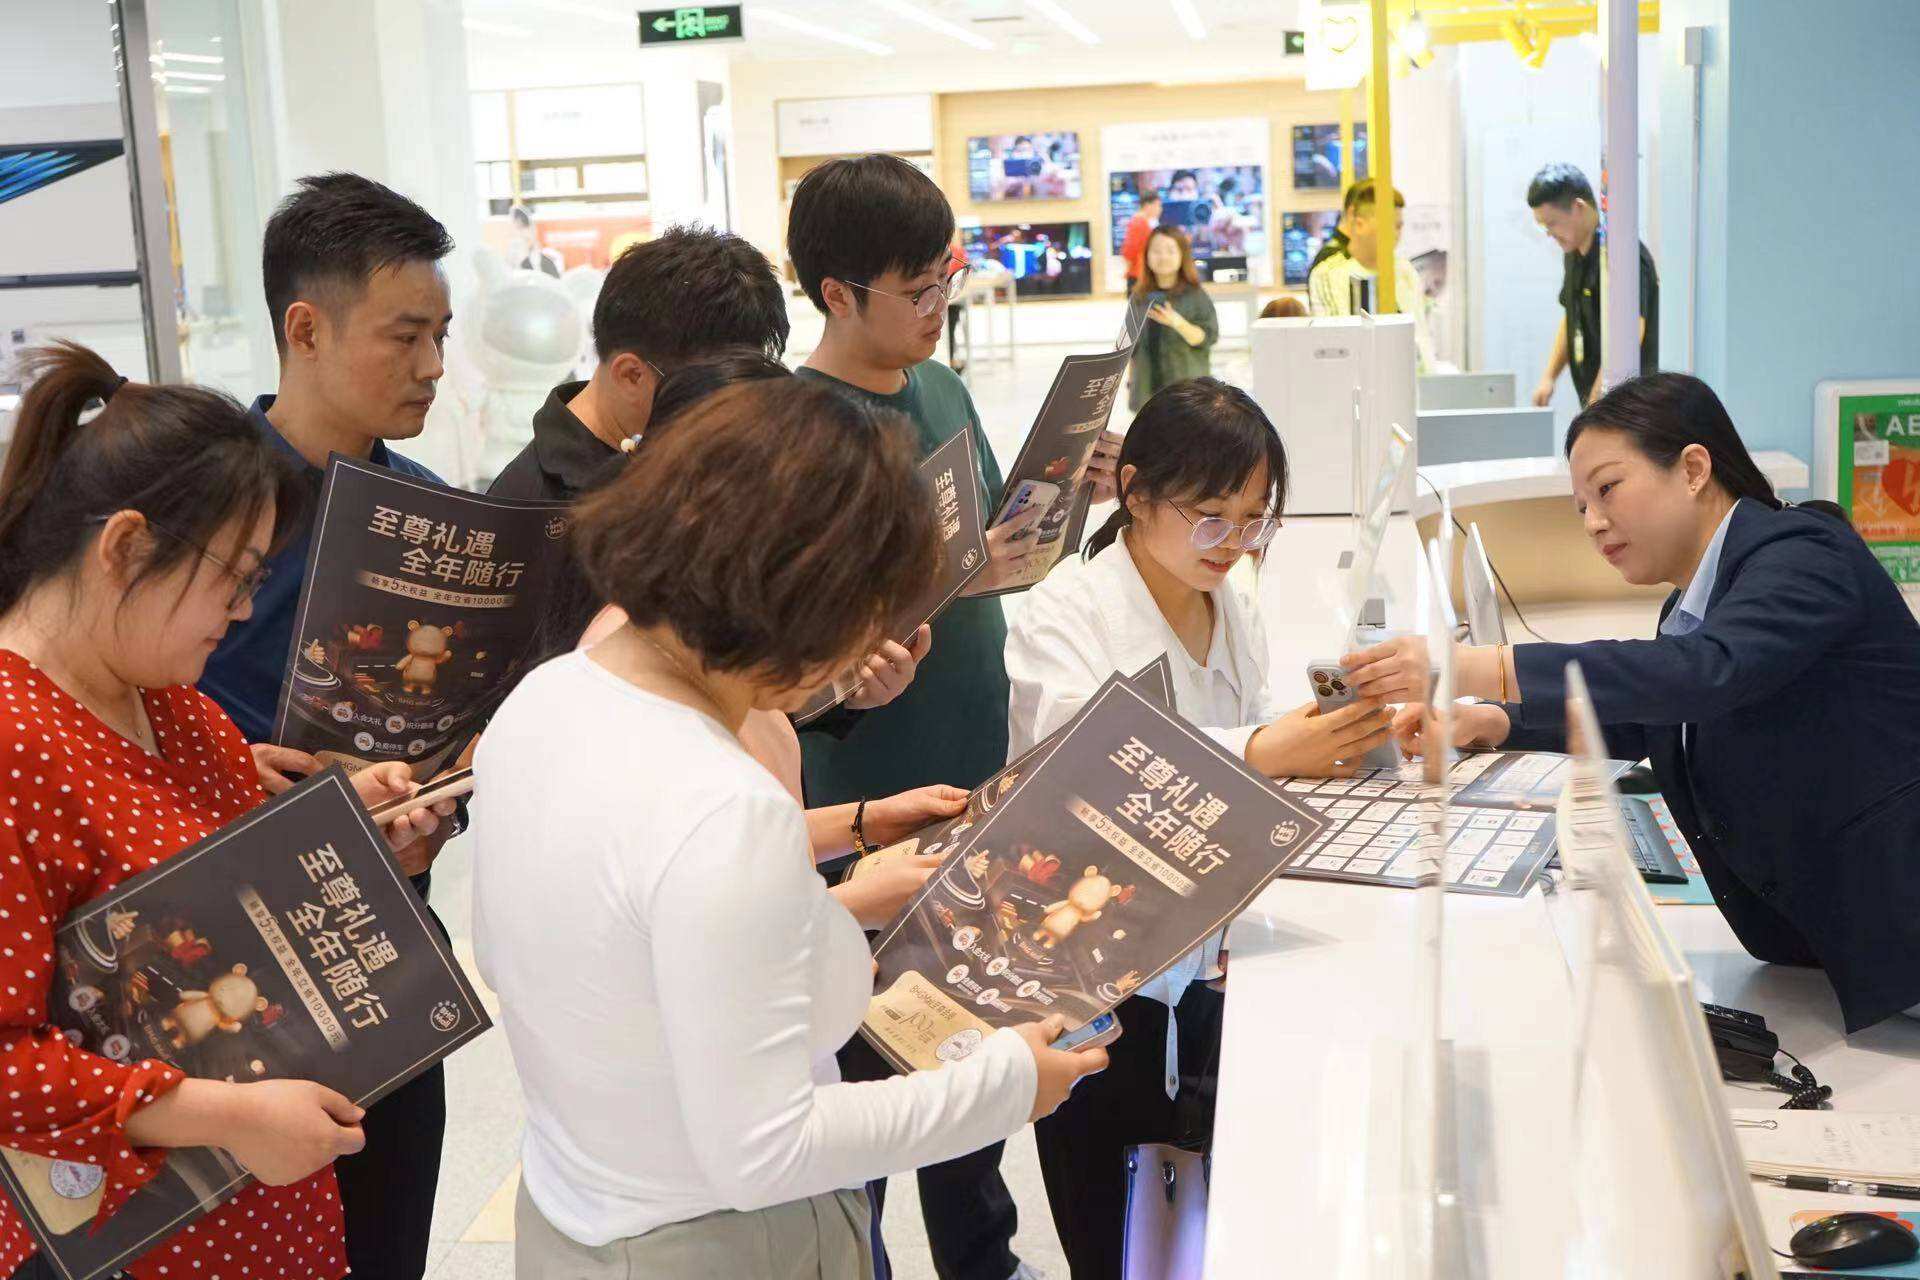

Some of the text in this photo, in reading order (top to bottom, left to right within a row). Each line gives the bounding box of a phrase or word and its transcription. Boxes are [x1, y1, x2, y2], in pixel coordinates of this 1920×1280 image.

[367, 505, 496, 559] 至尊礼遇
[399, 548, 524, 588] 全年随行
[1108, 736, 1229, 831] 至尊礼遇
[1115, 792, 1231, 875] 全年随行
[298, 843, 398, 974] 至尊礼遇
[286, 901, 389, 1028] 全年随行
